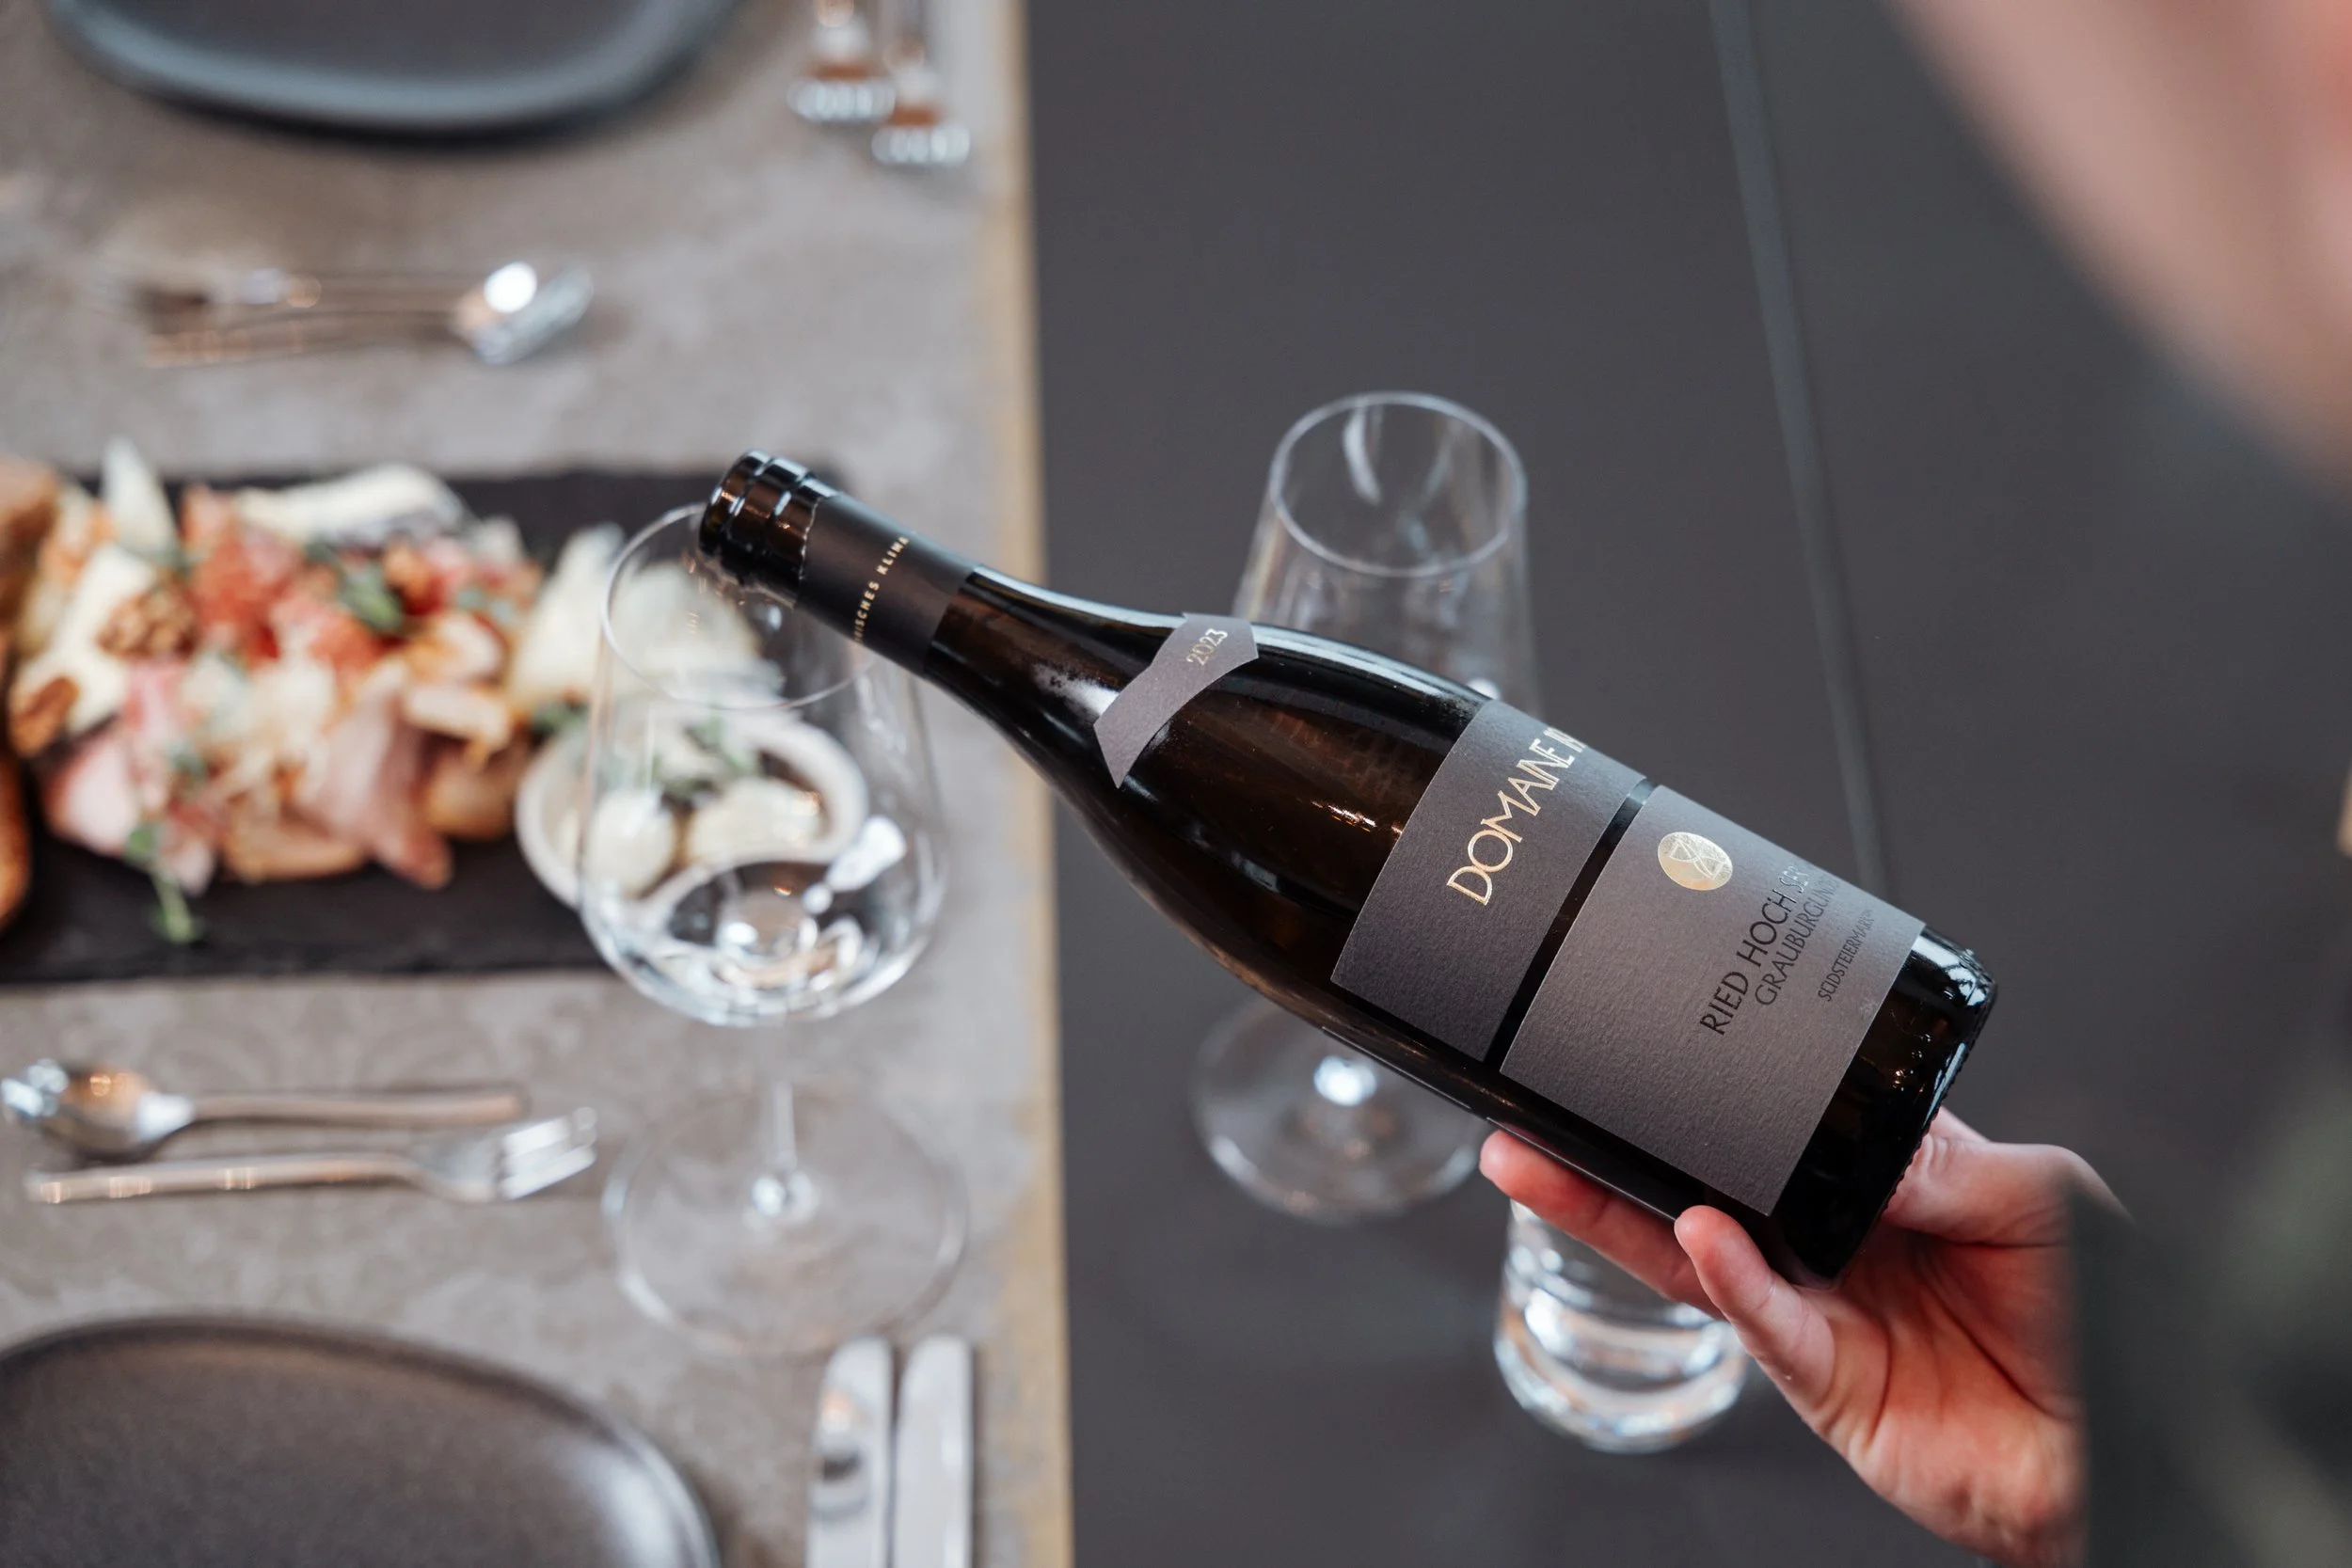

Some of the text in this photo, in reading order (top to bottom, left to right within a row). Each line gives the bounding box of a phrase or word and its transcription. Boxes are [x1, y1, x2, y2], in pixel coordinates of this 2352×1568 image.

[1185, 627, 1229, 665] 2023
[1447, 737, 1576, 906] DOMAINE
[1699, 863, 1810, 1036] RIED HOCH SER
